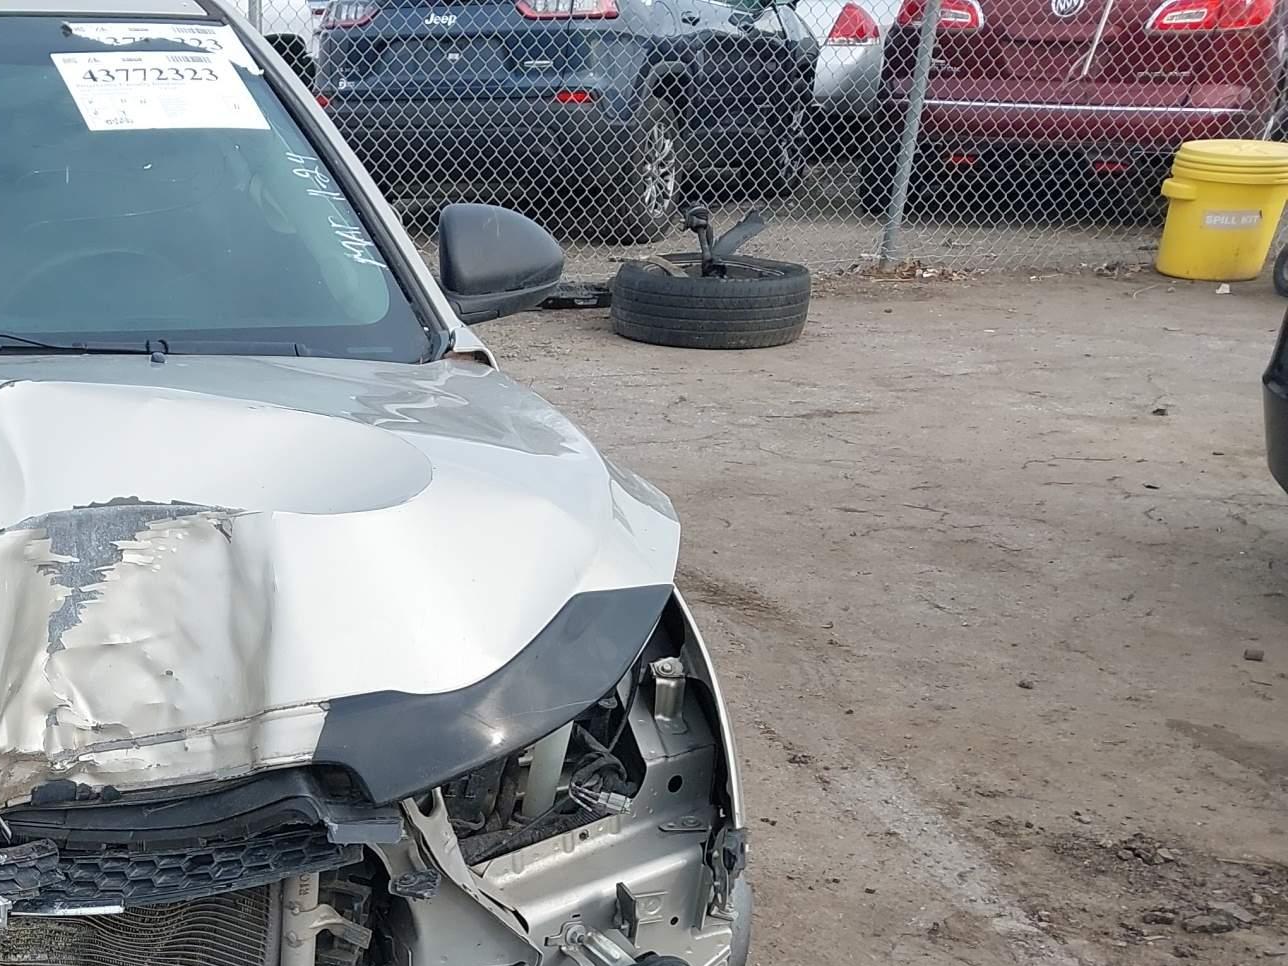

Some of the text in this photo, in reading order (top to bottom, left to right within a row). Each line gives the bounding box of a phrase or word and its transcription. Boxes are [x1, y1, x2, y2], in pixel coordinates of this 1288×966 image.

[424, 12, 457, 26] Jeep
[82, 67, 219, 82] 43772323
[1205, 215, 1258, 225] SPILL KIT
